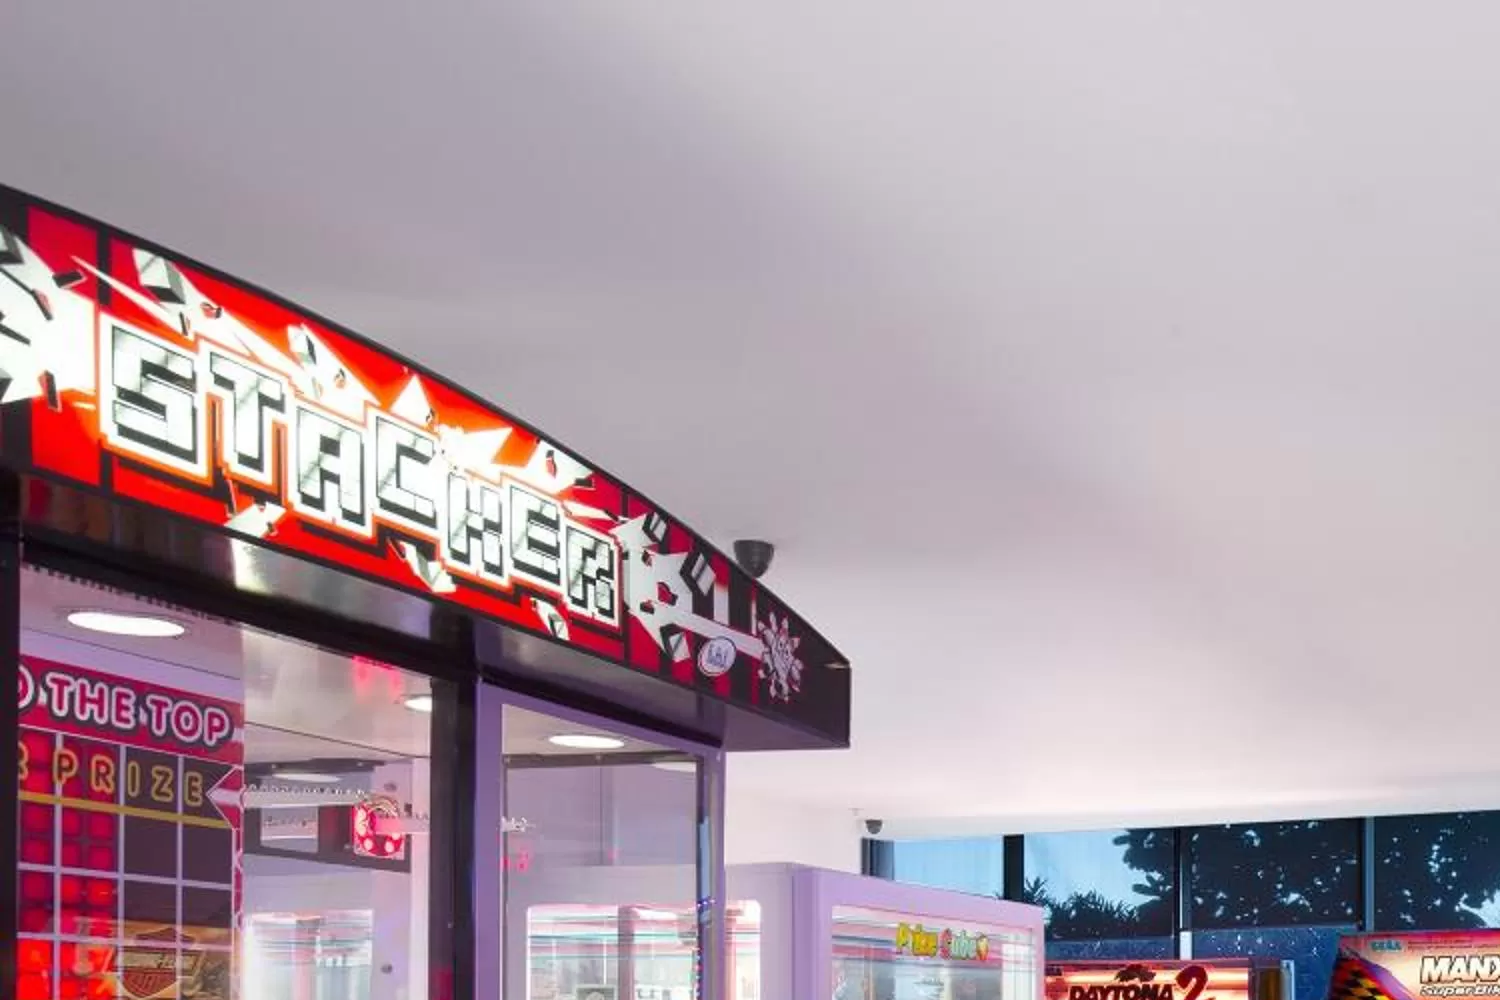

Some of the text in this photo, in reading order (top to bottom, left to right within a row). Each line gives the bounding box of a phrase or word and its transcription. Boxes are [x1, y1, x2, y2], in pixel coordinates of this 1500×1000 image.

[102, 320, 621, 625] STACKER
[46, 672, 135, 729] THE
[146, 694, 229, 747] TOP
[53, 749, 203, 806] PRIZE
